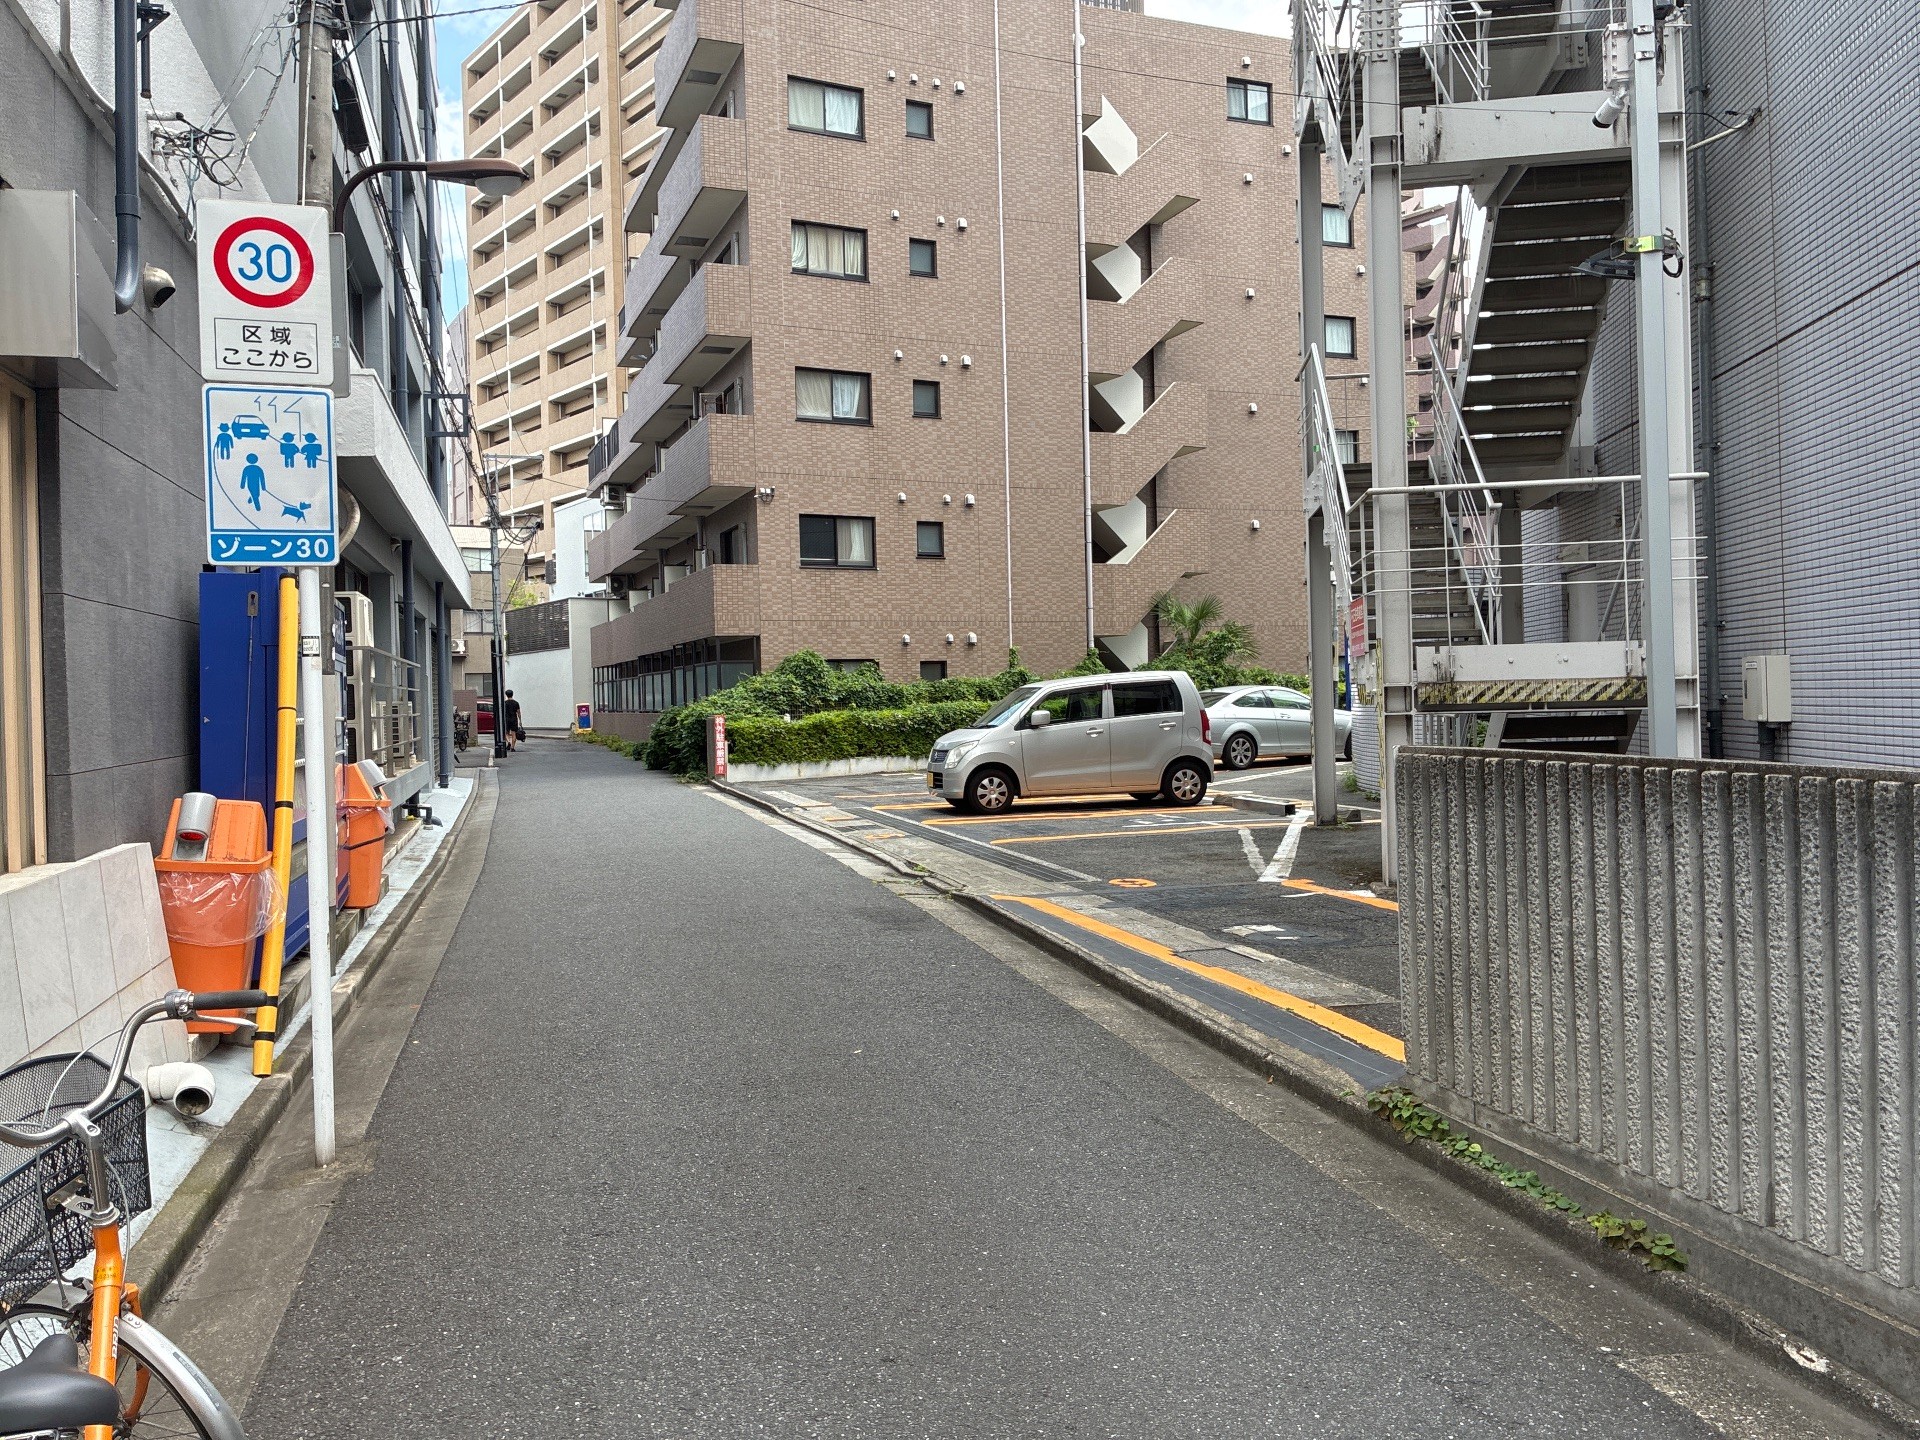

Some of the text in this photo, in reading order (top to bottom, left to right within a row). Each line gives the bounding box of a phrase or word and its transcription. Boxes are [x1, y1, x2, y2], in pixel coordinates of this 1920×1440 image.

[238, 241, 292, 283] 30
[242, 325, 292, 345] 区域
[223, 347, 312, 369] ここから
[217, 536, 329, 559] ゾーン30
